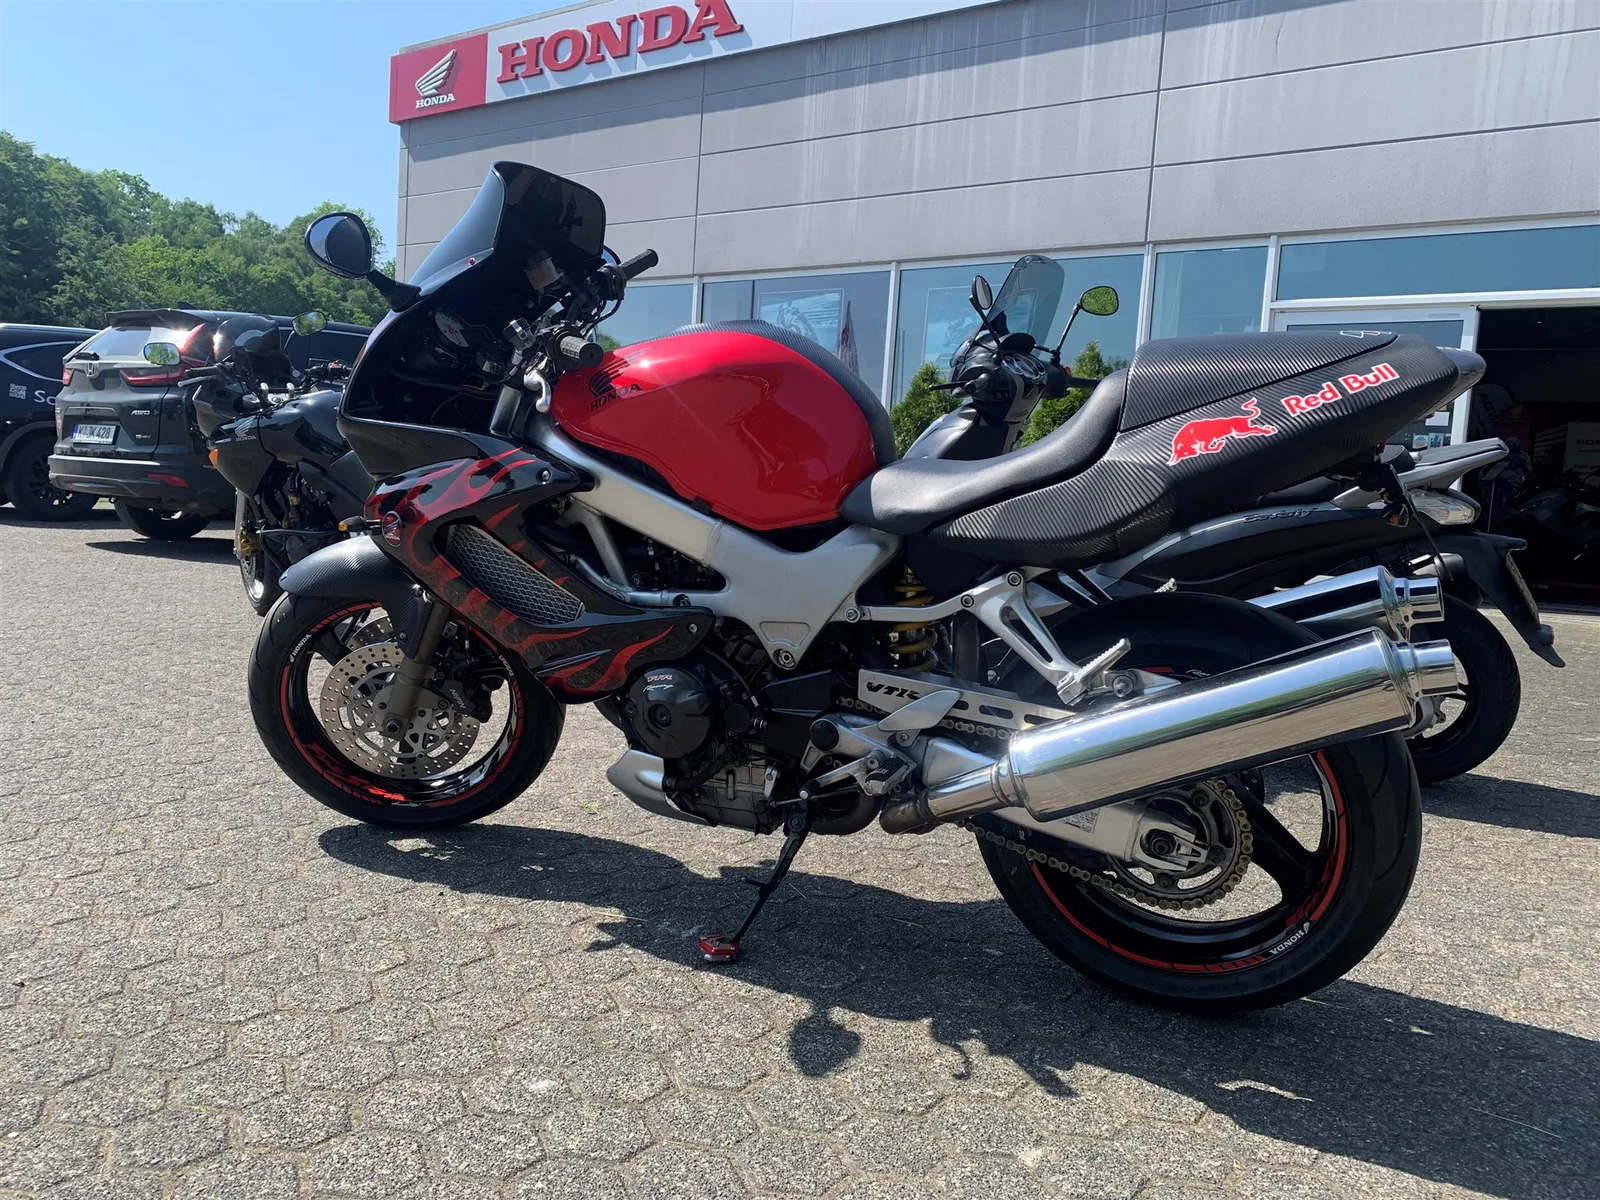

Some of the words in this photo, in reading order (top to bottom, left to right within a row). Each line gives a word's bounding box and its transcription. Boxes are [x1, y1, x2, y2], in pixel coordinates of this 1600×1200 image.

[496, 0, 744, 84] HONDA
[415, 93, 456, 109] HONDA
[590, 383, 643, 411] HONDA
[1281, 382, 1342, 417] Red
[1338, 362, 1400, 394] Bull
[291, 634, 312, 656] HONDA
[1269, 929, 1305, 955] HONDA
